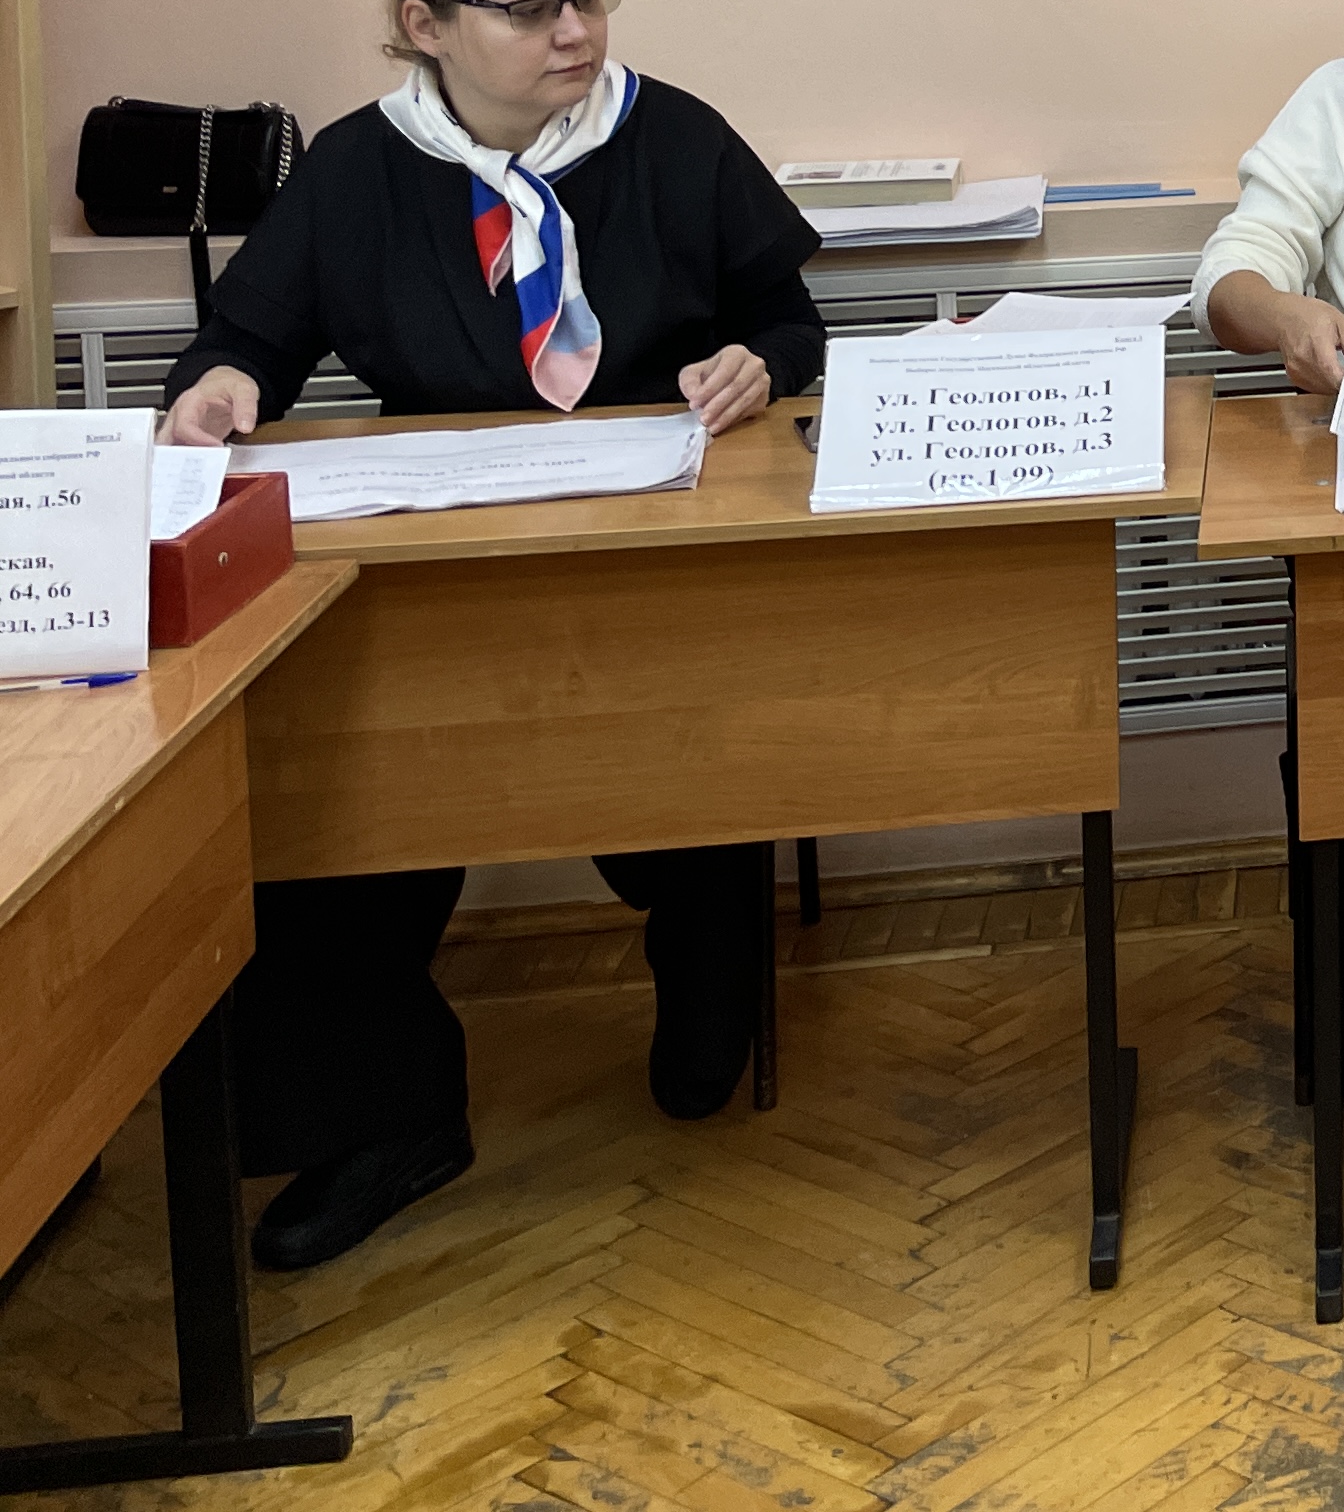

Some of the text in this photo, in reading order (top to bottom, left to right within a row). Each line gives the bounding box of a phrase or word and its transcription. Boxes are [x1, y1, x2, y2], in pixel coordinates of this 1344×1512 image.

[875, 379, 1113, 412] ул. Геологов, д.1
[872, 405, 1113, 439] ул. Геологов, д.2
[870, 431, 1113, 467] ул. Геологов, д.3
[37, 488, 82, 509] д.56
[9, 580, 72, 605] 64, 66
[42, 609, 110, 633] д.3-13
